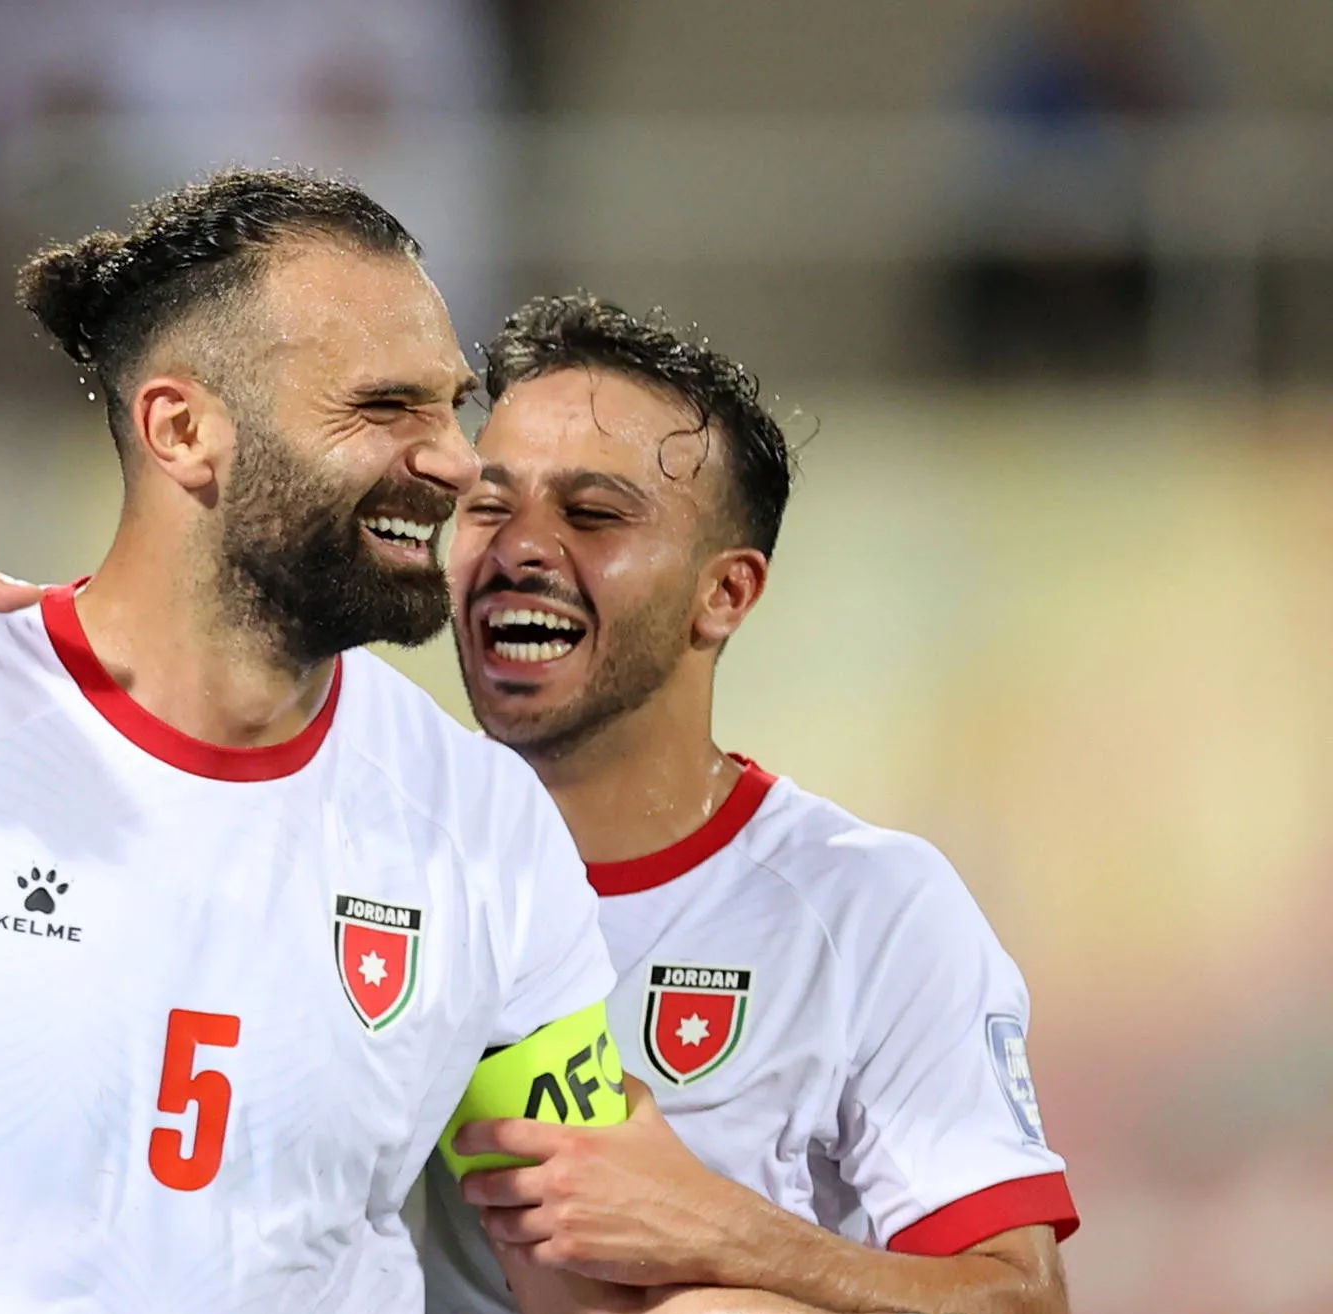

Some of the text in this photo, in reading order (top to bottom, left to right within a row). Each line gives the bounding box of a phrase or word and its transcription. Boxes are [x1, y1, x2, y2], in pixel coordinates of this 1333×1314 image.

[345, 898, 411, 927] JORDAN
[661, 967, 740, 989] JORDAN
[149, 1008, 241, 1192] 5
[523, 1030, 625, 1124] AFC
